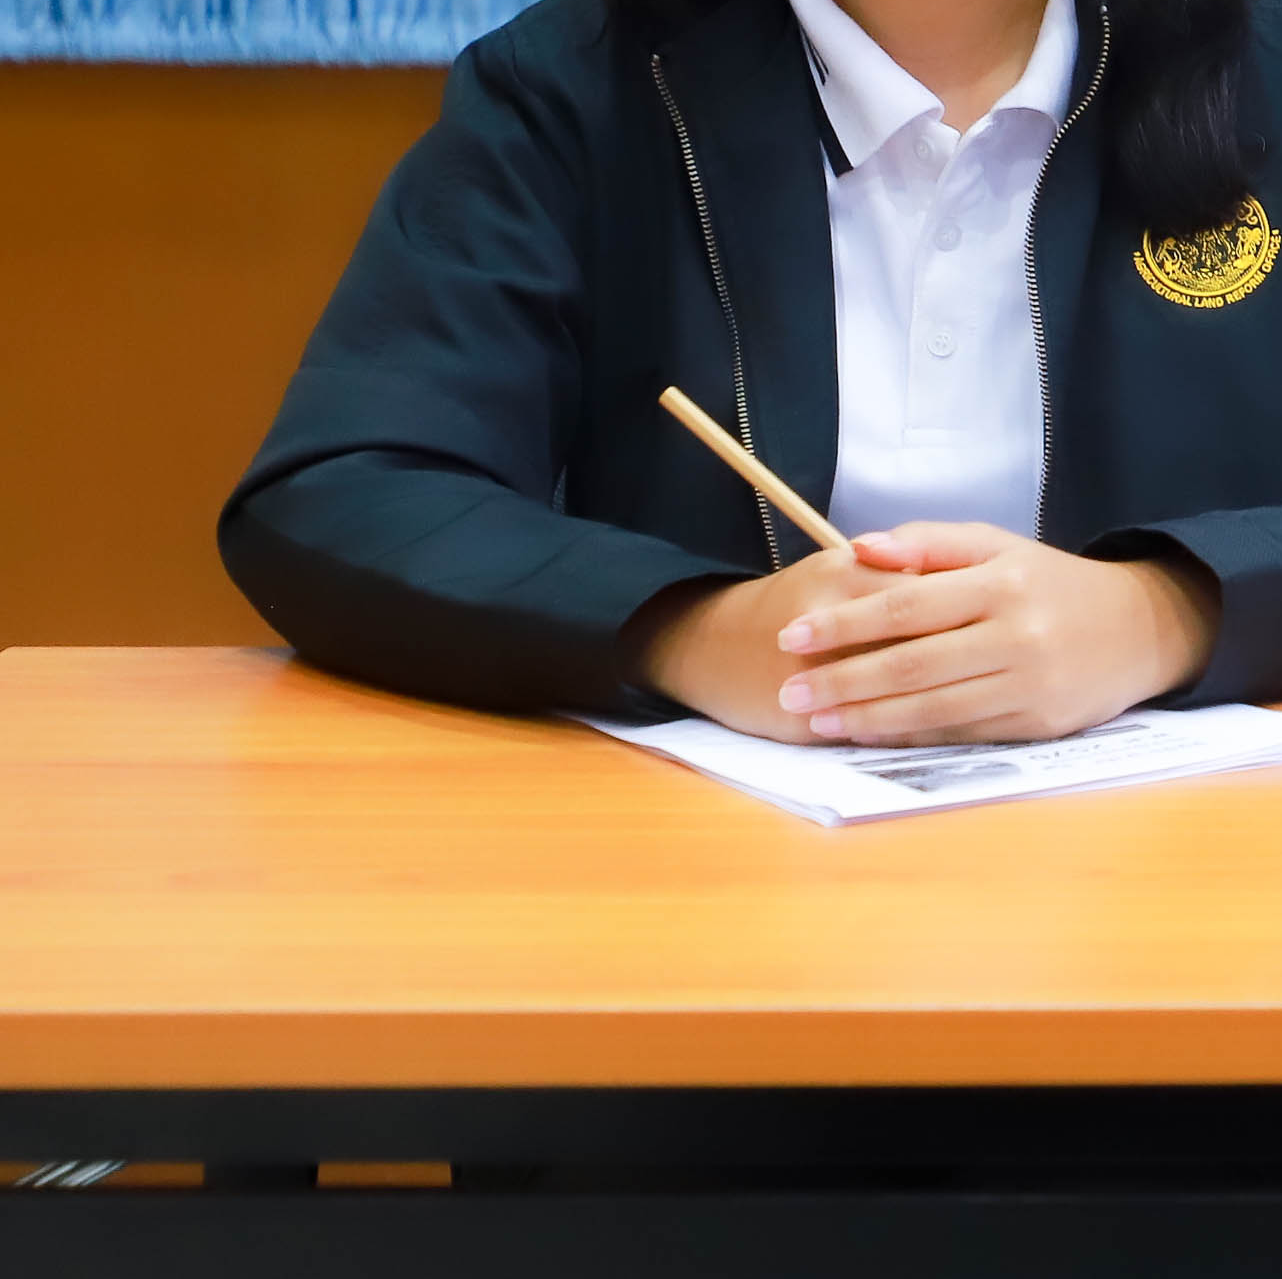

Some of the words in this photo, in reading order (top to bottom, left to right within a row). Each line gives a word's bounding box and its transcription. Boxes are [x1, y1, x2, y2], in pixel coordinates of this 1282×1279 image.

[1193, 296, 1224, 309] LAND
[1225, 270, 1266, 304] REFORM
[1262, 235, 1281, 273] OFFICE
